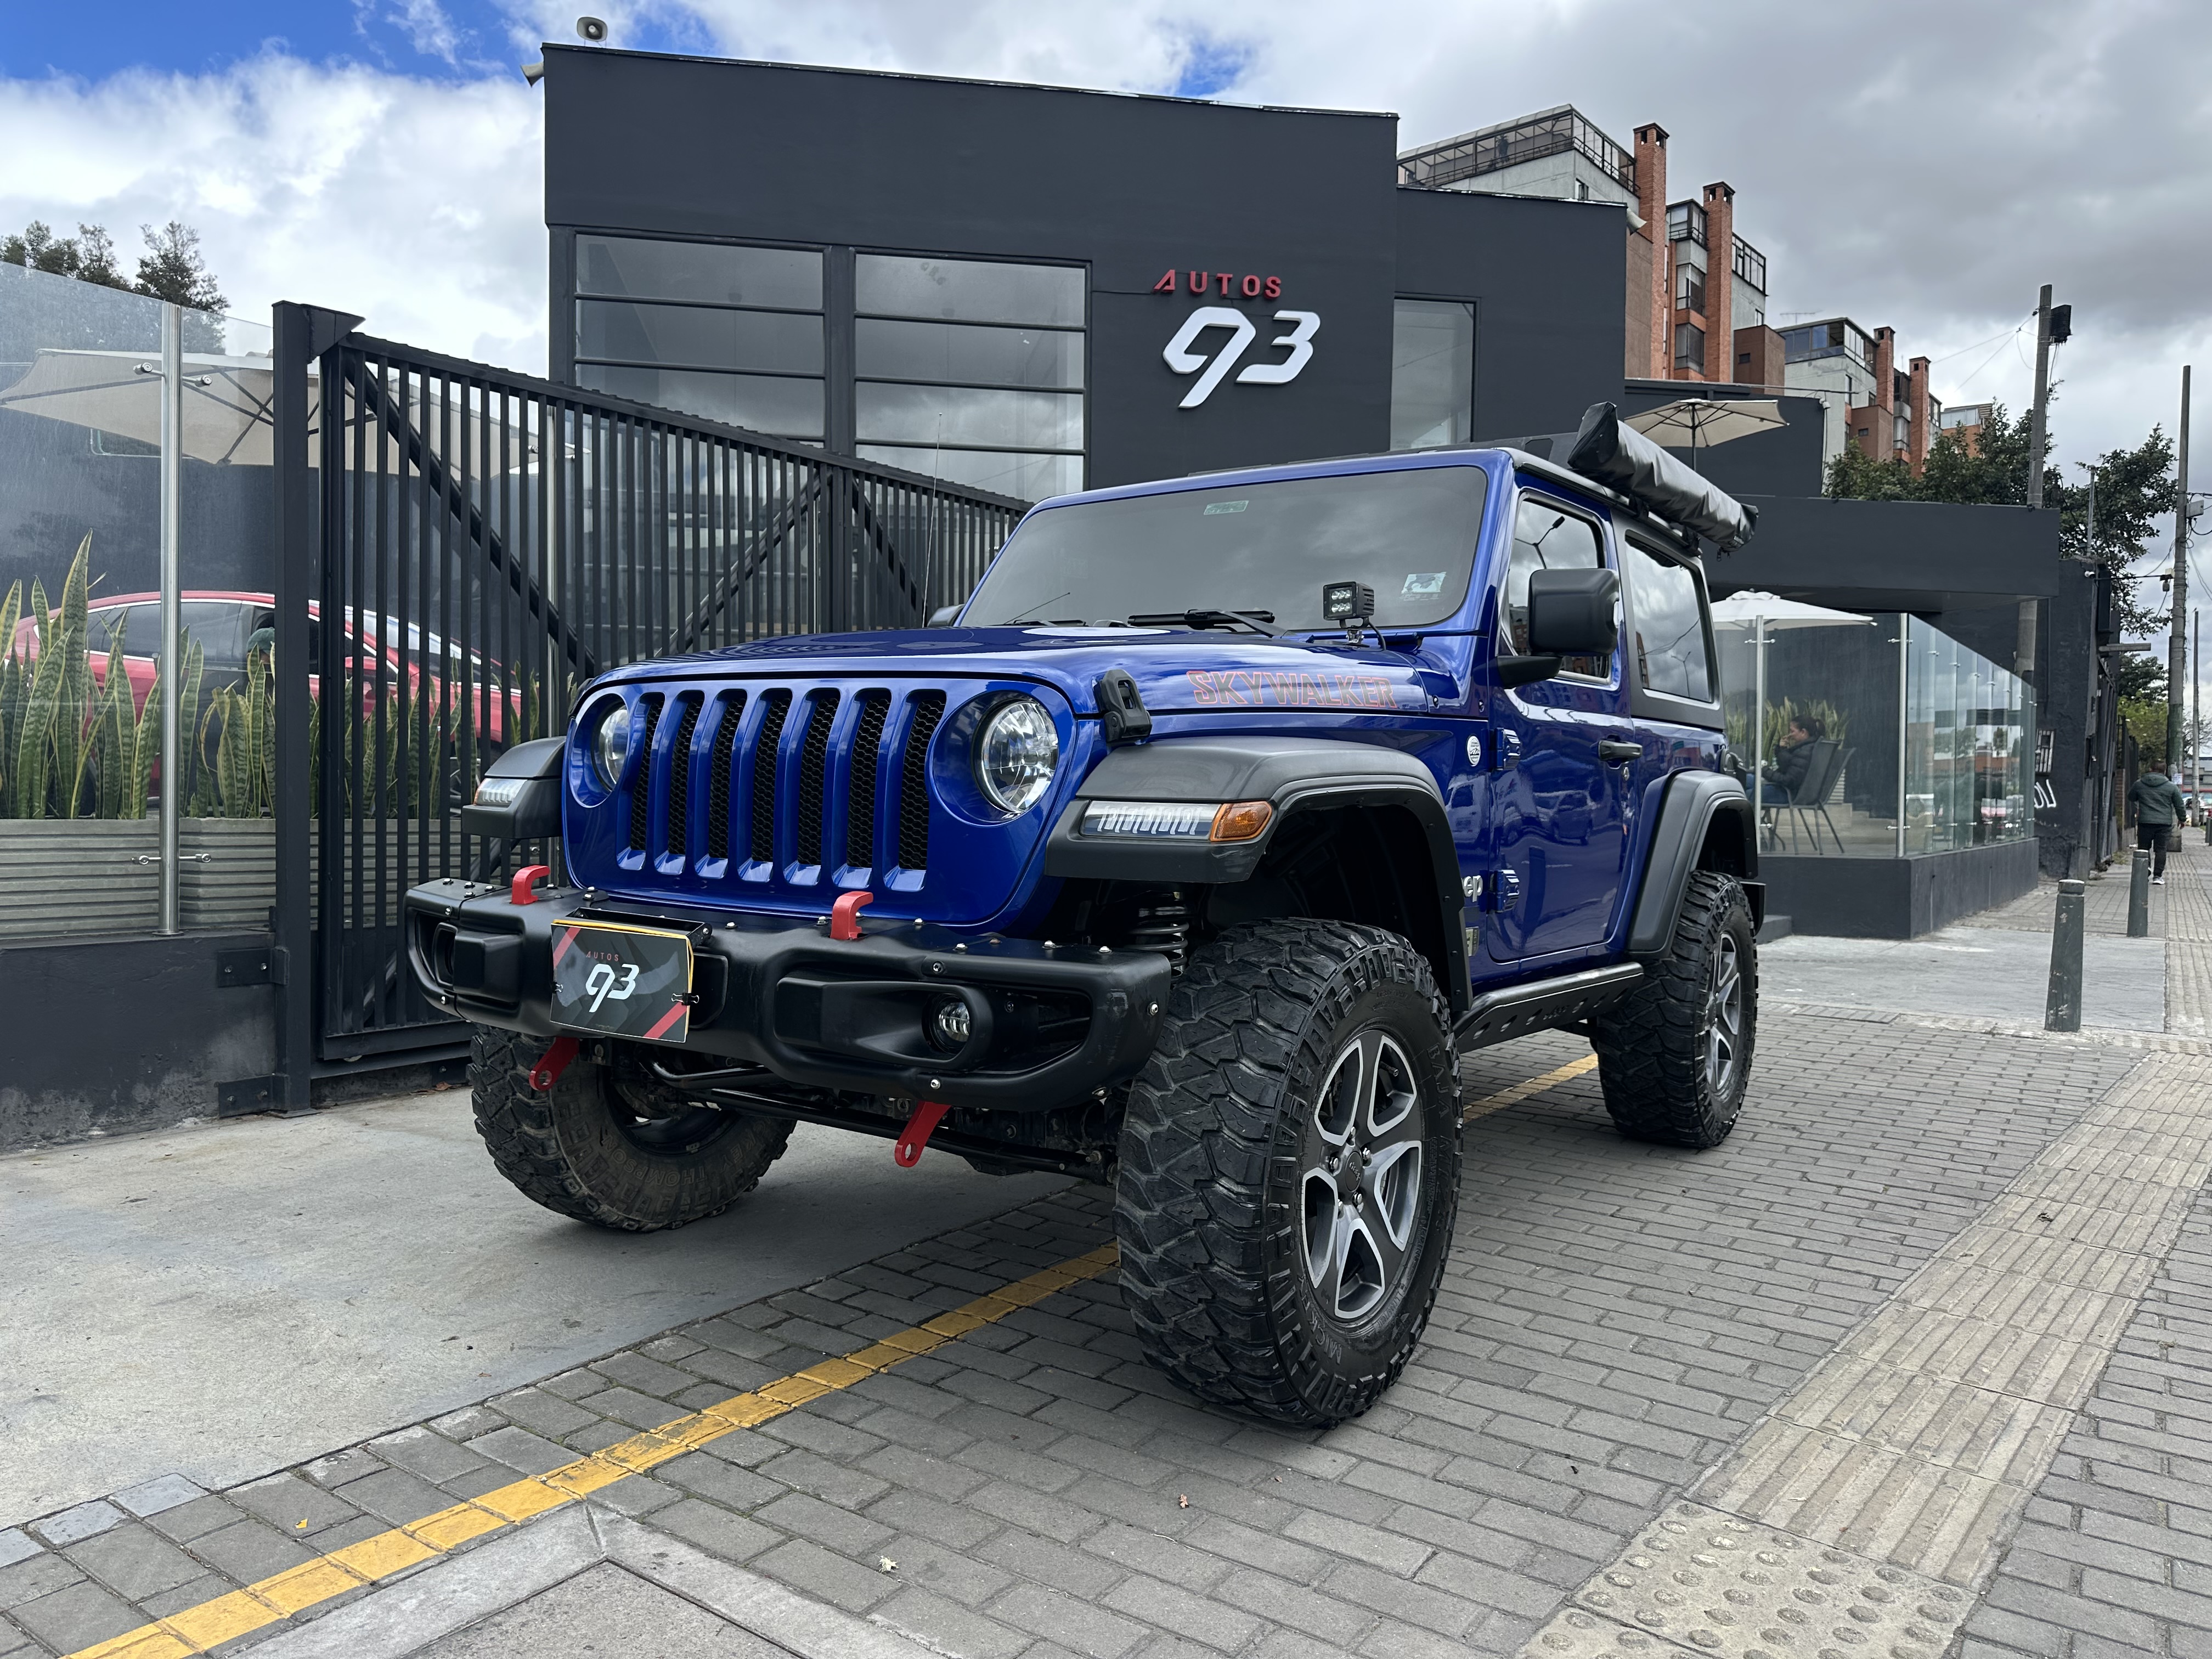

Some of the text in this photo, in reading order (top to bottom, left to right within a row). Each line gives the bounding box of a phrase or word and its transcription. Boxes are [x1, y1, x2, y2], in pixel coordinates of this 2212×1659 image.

[1153, 269, 1282, 300] AUTOS
[1162, 306, 1321, 409] 93
[1186, 670, 1398, 709] SKYWALKER
[585, 950, 620, 962] AUTOS
[585, 963, 640, 1013] 93
[1426, 1042, 1451, 1120] BAJA
[602, 1115, 772, 1187] ICKEY THOMPSON
[1297, 1274, 1342, 1365] MICKEY
